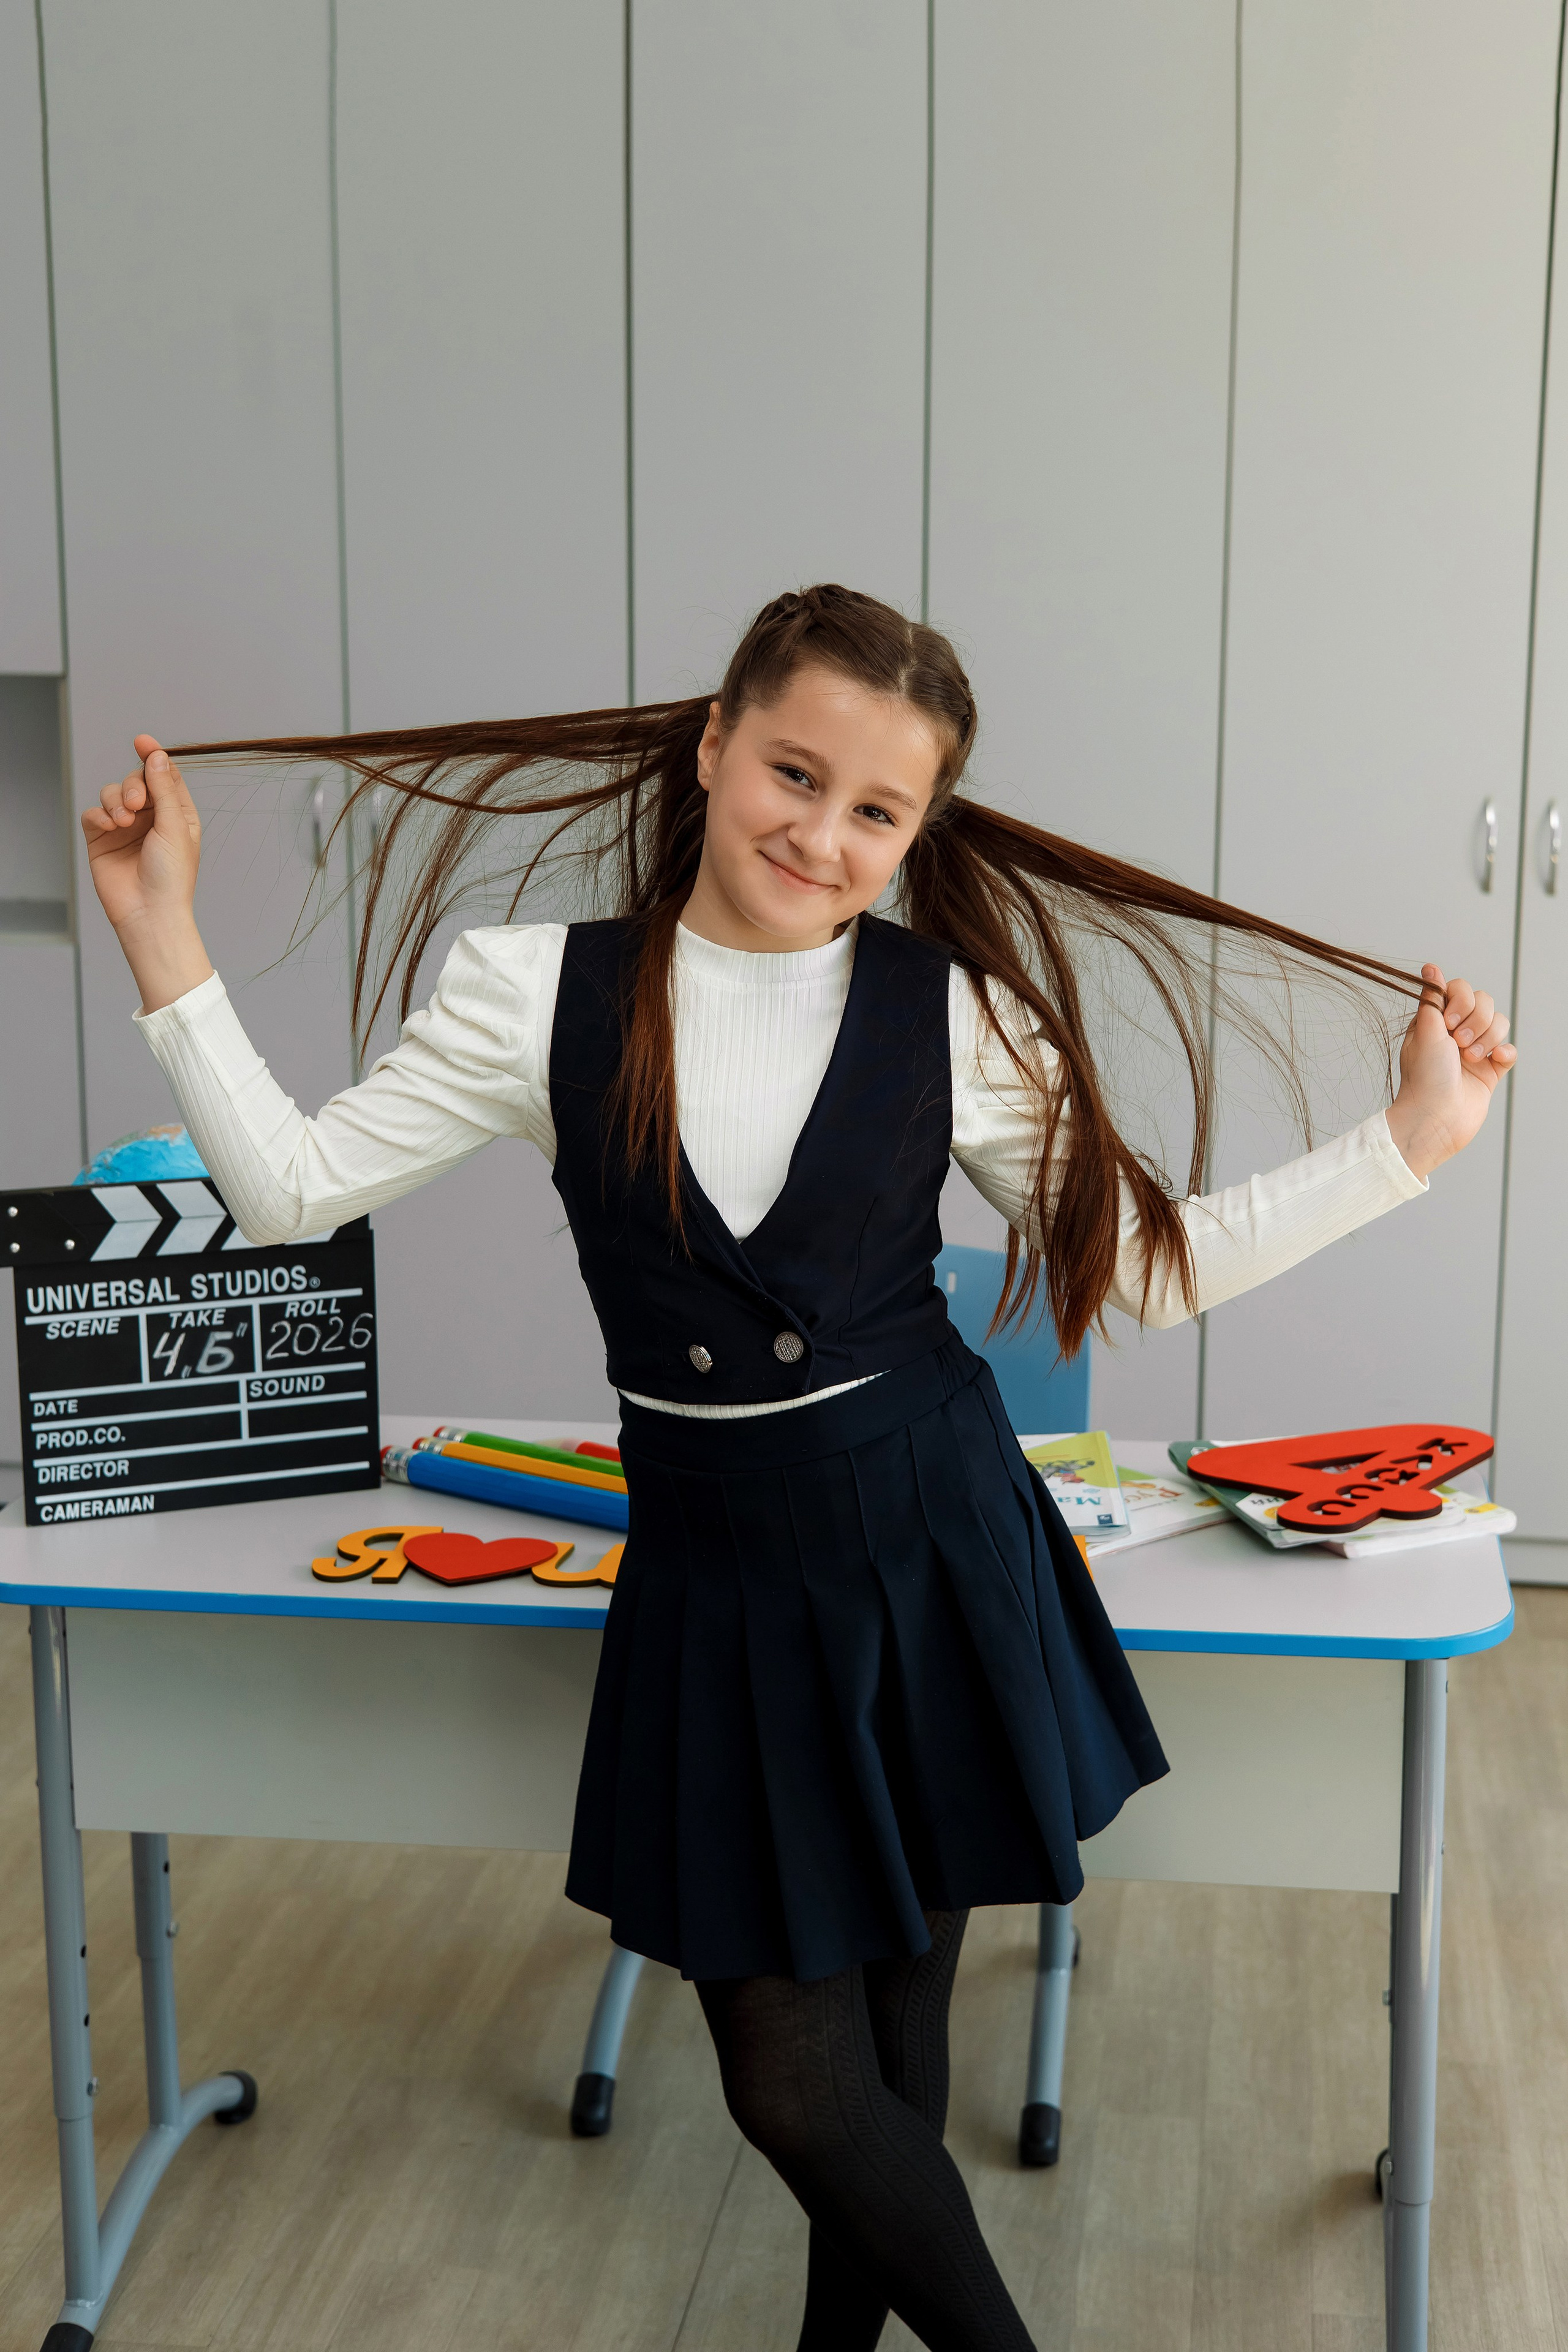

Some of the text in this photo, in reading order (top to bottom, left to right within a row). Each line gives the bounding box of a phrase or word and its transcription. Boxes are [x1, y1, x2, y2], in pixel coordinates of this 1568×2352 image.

[26, 1276, 180, 1314] UNIVERSAL
[169, 1308, 227, 1330] TAKE
[285, 1297, 341, 1319] ROLL
[46, 1317, 121, 1340] SCENE
[265, 1313, 374, 1360] 2026
[250, 1374, 326, 1398] SOUND
[34, 1400, 78, 1417] DATE
[36, 1427, 126, 1450] PROD.CO.
[38, 1460, 129, 1484] DIRECTOR
[41, 1494, 155, 1523] CAMERAMAN
